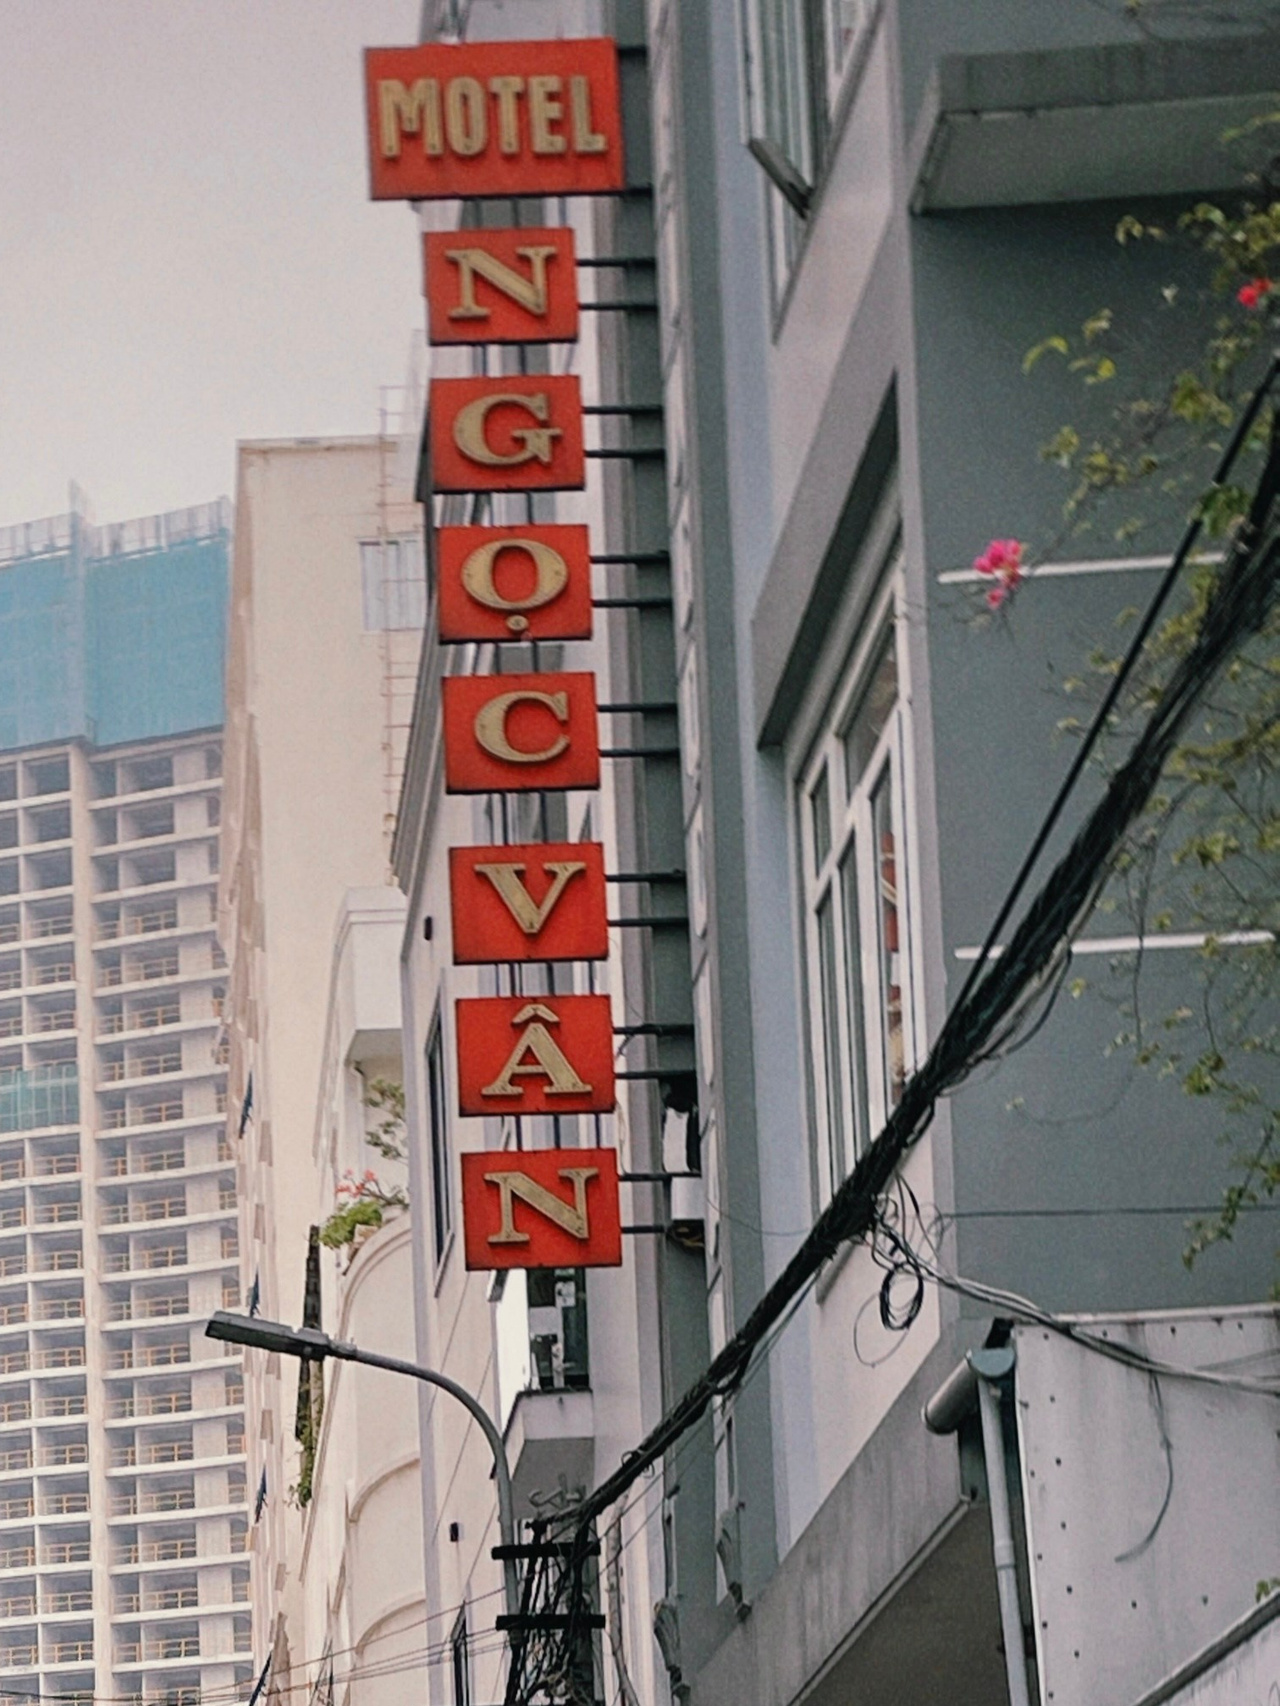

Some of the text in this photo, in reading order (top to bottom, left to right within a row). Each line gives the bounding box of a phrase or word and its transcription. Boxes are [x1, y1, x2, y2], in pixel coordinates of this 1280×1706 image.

[376, 74, 608, 160] MOTEL
[444, 244, 572, 764] NGỌC
[473, 860, 600, 1245] VÂN
